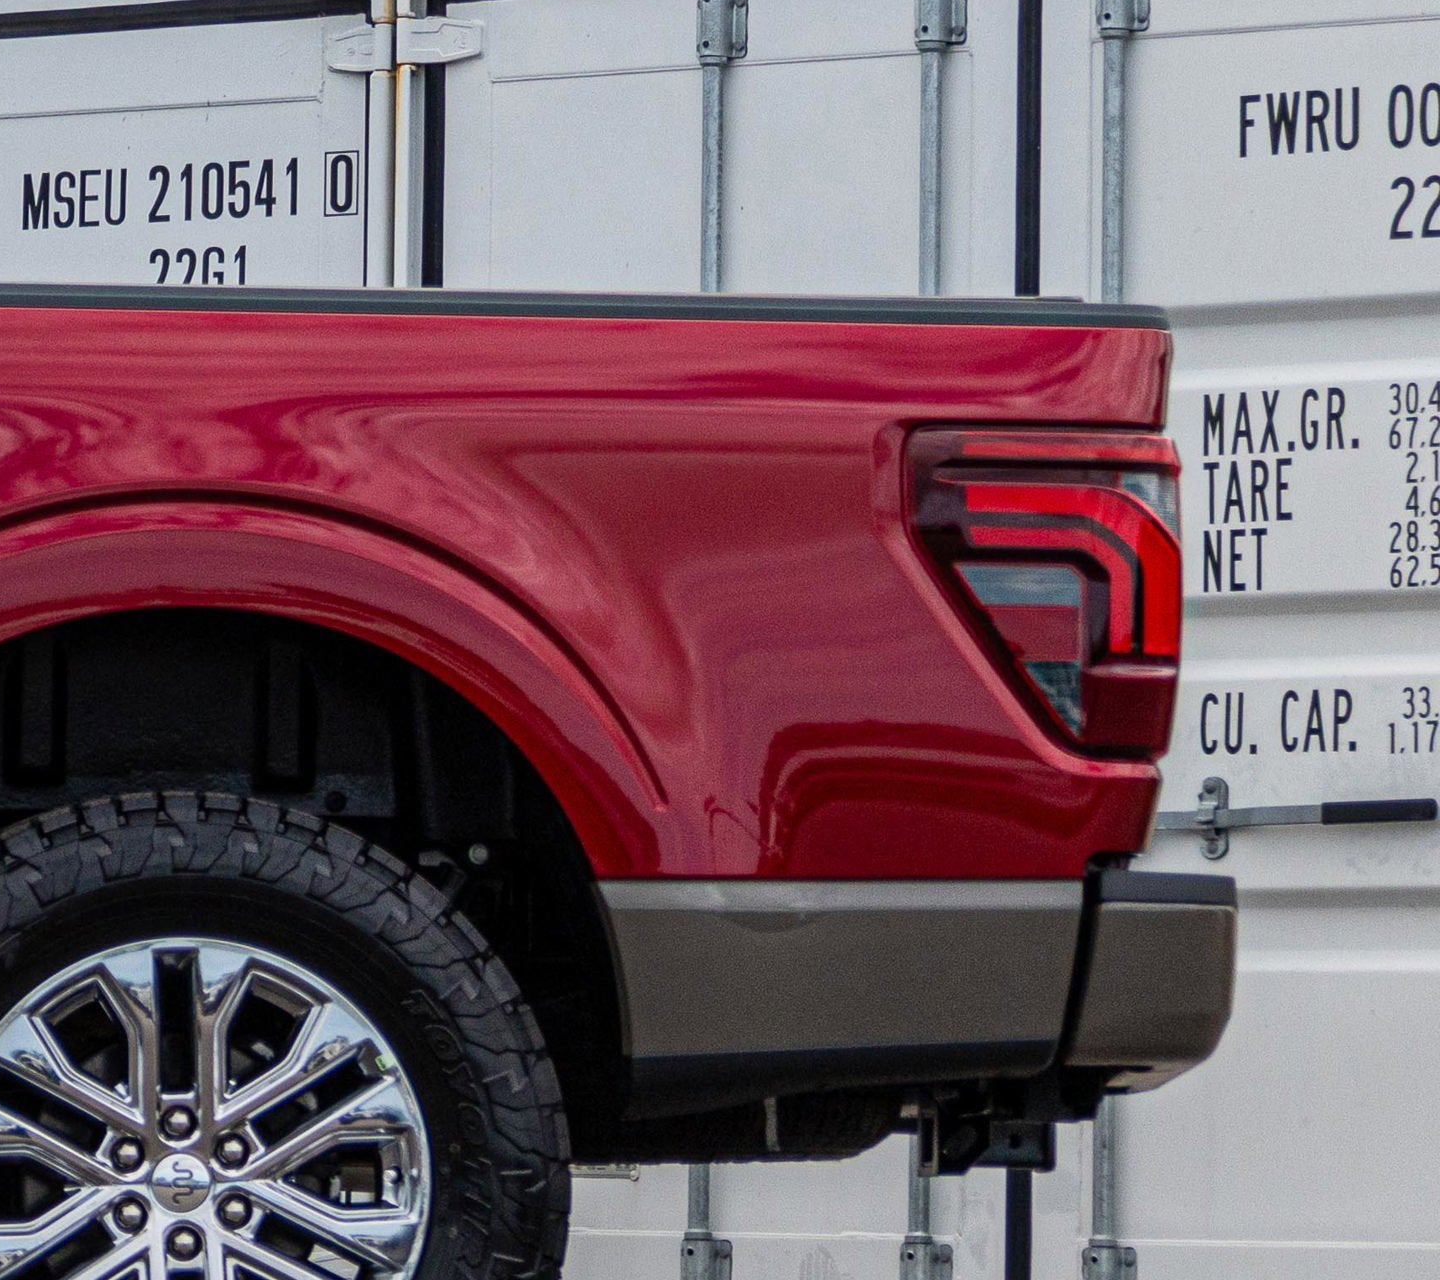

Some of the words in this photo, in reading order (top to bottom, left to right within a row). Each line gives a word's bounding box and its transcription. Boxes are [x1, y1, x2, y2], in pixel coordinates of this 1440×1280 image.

[1240, 87, 1360, 158] FWRU
[22, 168, 127, 230] MSEU
[148, 157, 299, 223] 210541
[329, 154, 354, 213] 0
[1202, 387, 1360, 456] MAX.GR.
[1203, 458, 1293, 524] TARE
[1203, 528, 1268, 592] NET
[1200, 692, 1258, 755] CU.
[1280, 688, 1358, 753] CAP.
[399, 987, 488, 1147] TOYO
